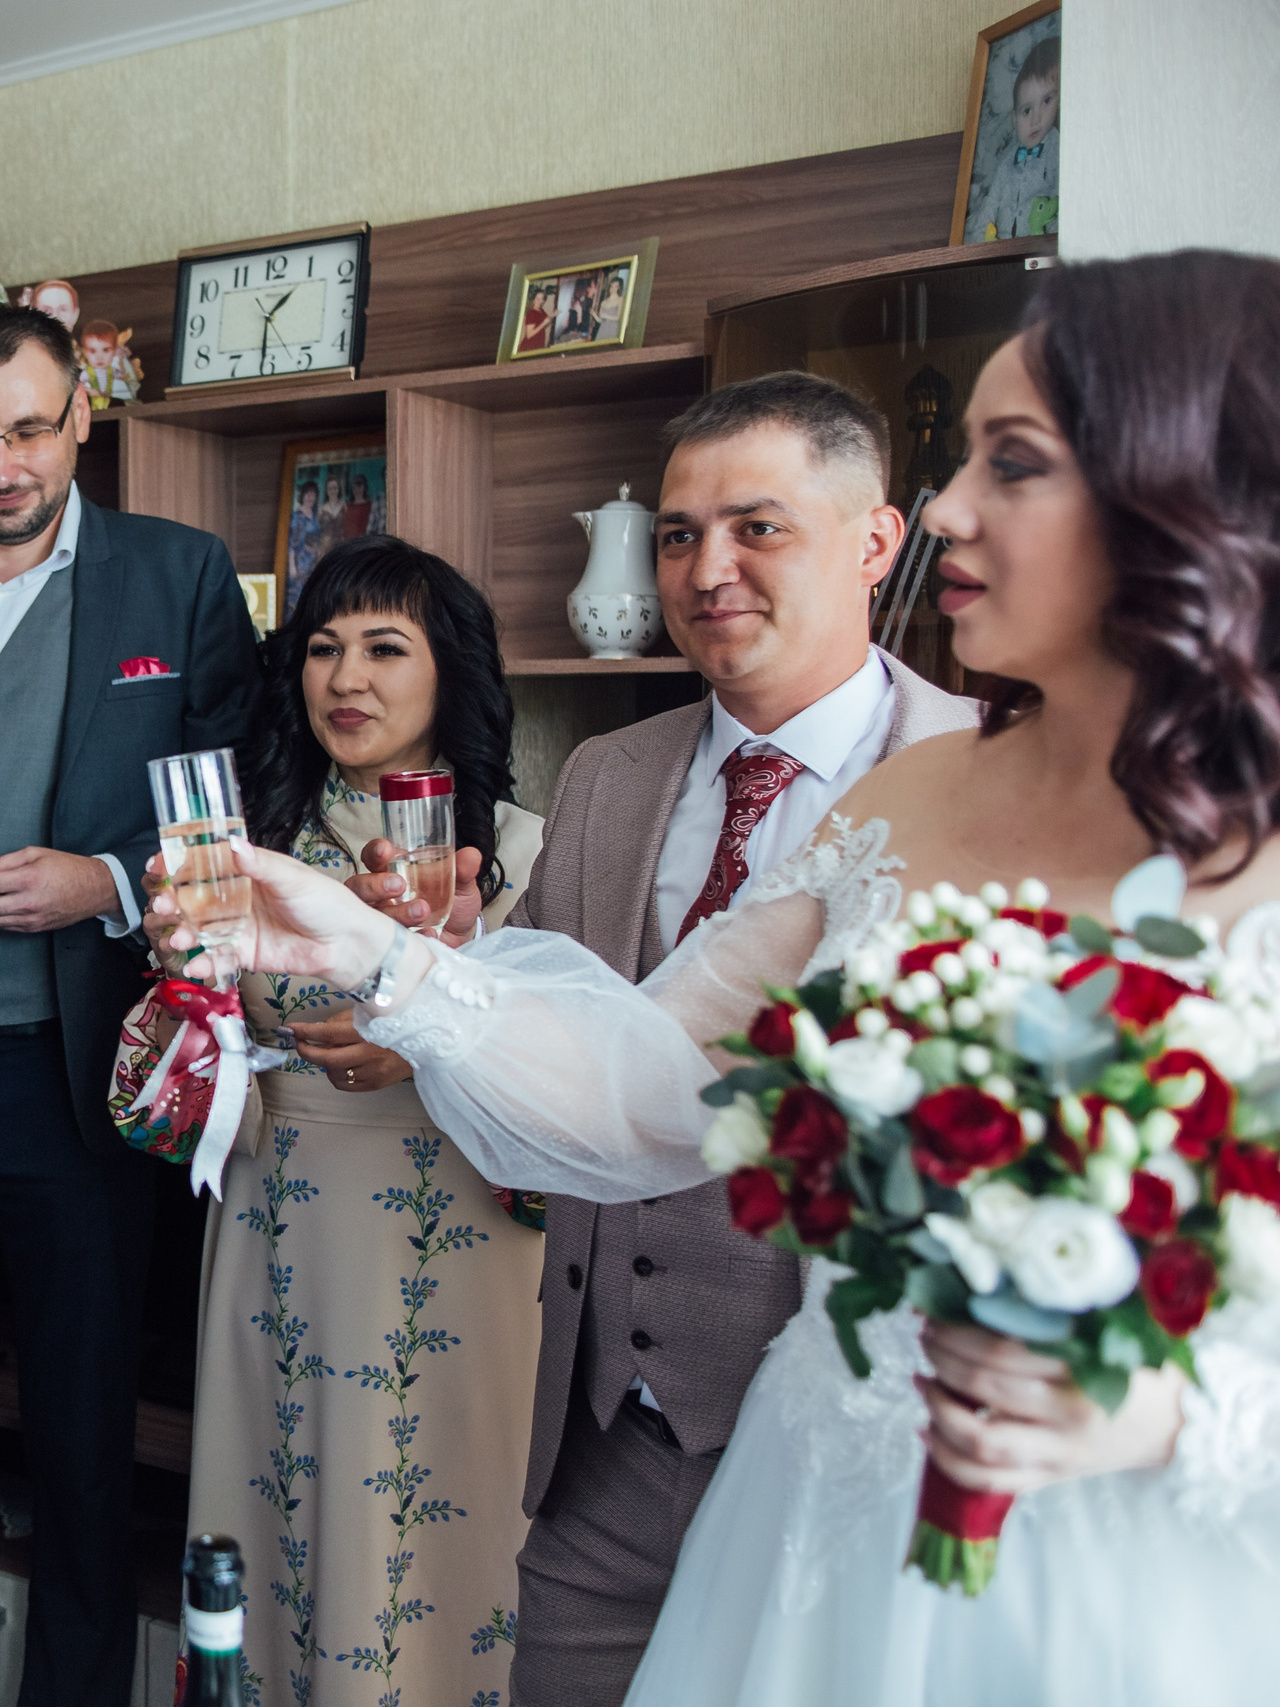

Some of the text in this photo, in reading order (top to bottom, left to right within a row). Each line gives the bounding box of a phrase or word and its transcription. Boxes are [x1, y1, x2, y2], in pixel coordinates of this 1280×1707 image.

[233, 265, 249, 288] 11
[265, 255, 288, 281] 12
[307, 255, 314, 278] 1
[337, 259, 355, 285] 2
[199, 278, 219, 304] 10
[189, 314, 206, 339] 9
[331, 329, 350, 353] 4
[194, 345, 211, 370] 8
[228, 354, 244, 378] 7
[259, 353, 276, 376] 6
[296, 346, 313, 372] 5
